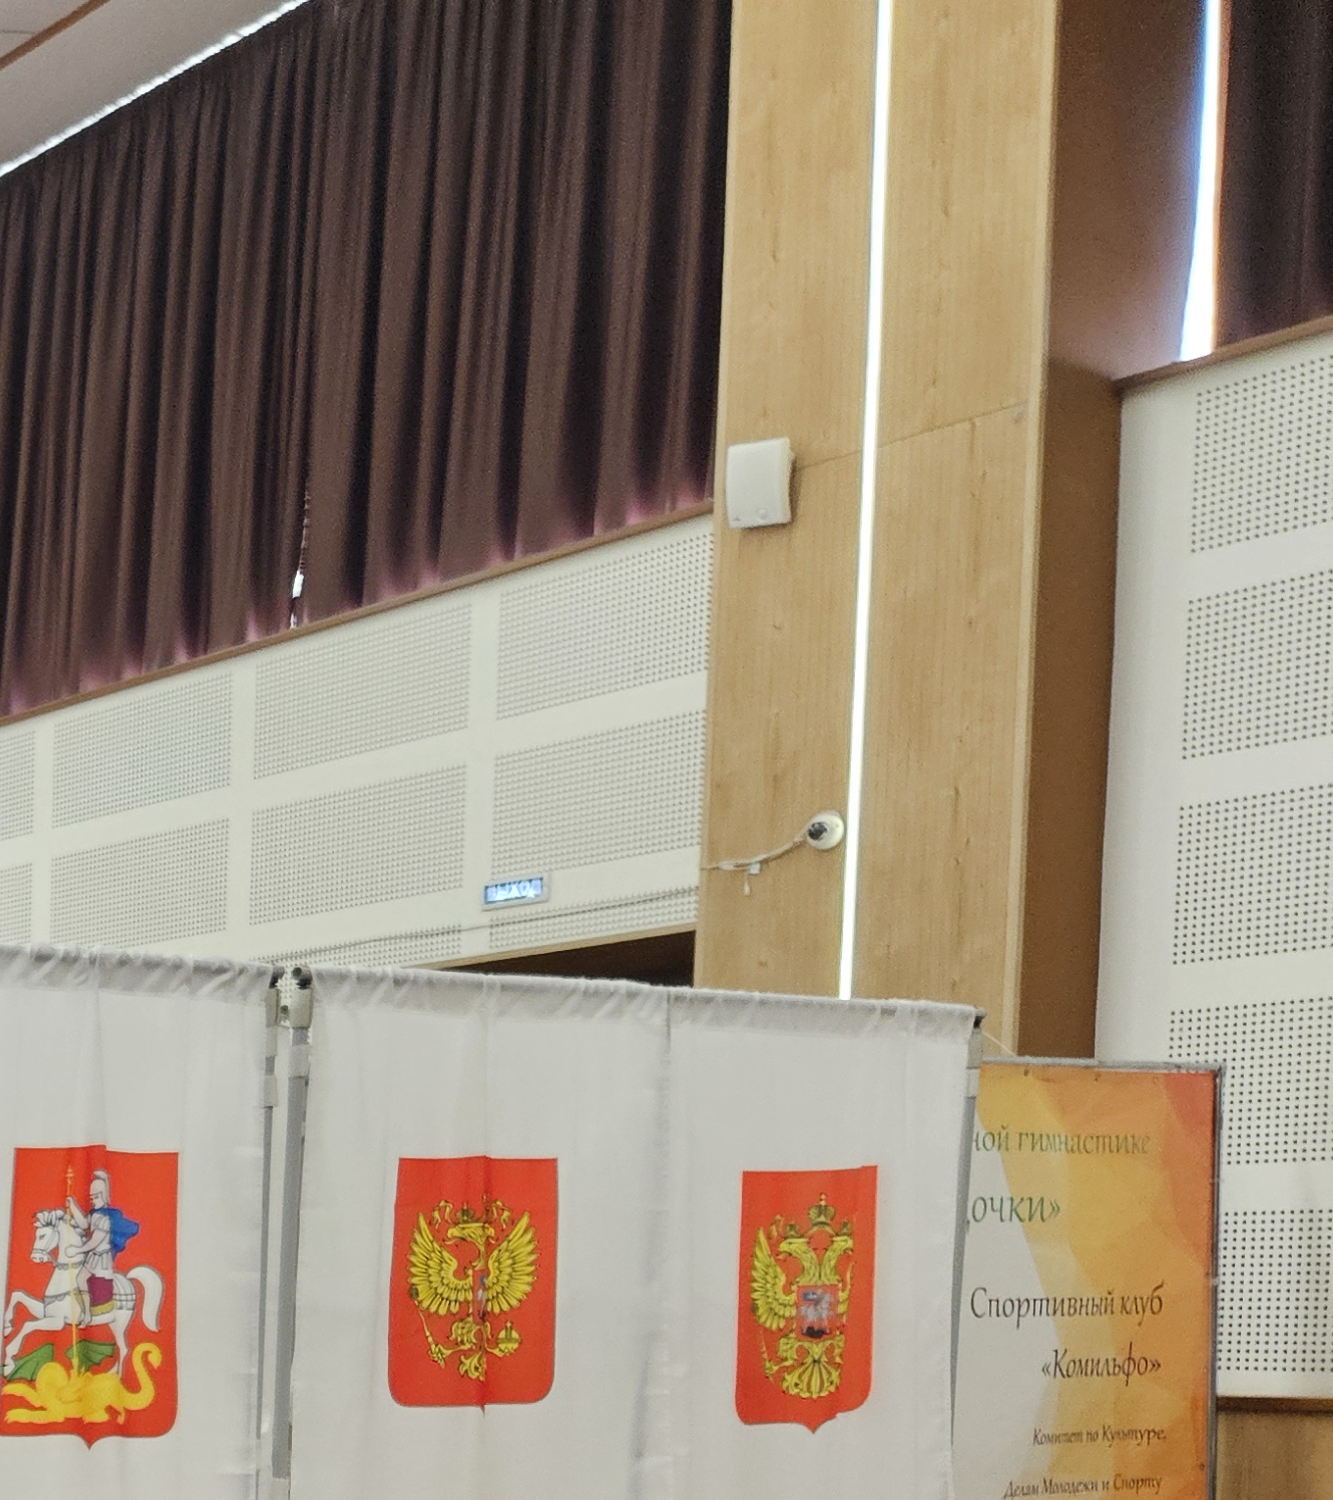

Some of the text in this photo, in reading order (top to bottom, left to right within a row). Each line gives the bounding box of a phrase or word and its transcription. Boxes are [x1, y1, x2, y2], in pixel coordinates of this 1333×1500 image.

[1018, 1130, 1151, 1154] гимнастике
[965, 1196, 1061, 1234] очки»
[970, 1280, 1165, 1330] Спортивный клуб
[1041, 1341, 1161, 1387] «Комильфо»
[1033, 1428, 1084, 1446] Комитет
[1086, 1430, 1099, 1443] по
[1041, 1477, 1099, 1496] Молодежи
[1102, 1479, 1110, 1491] и
[1113, 1473, 1163, 1494] Спорту
